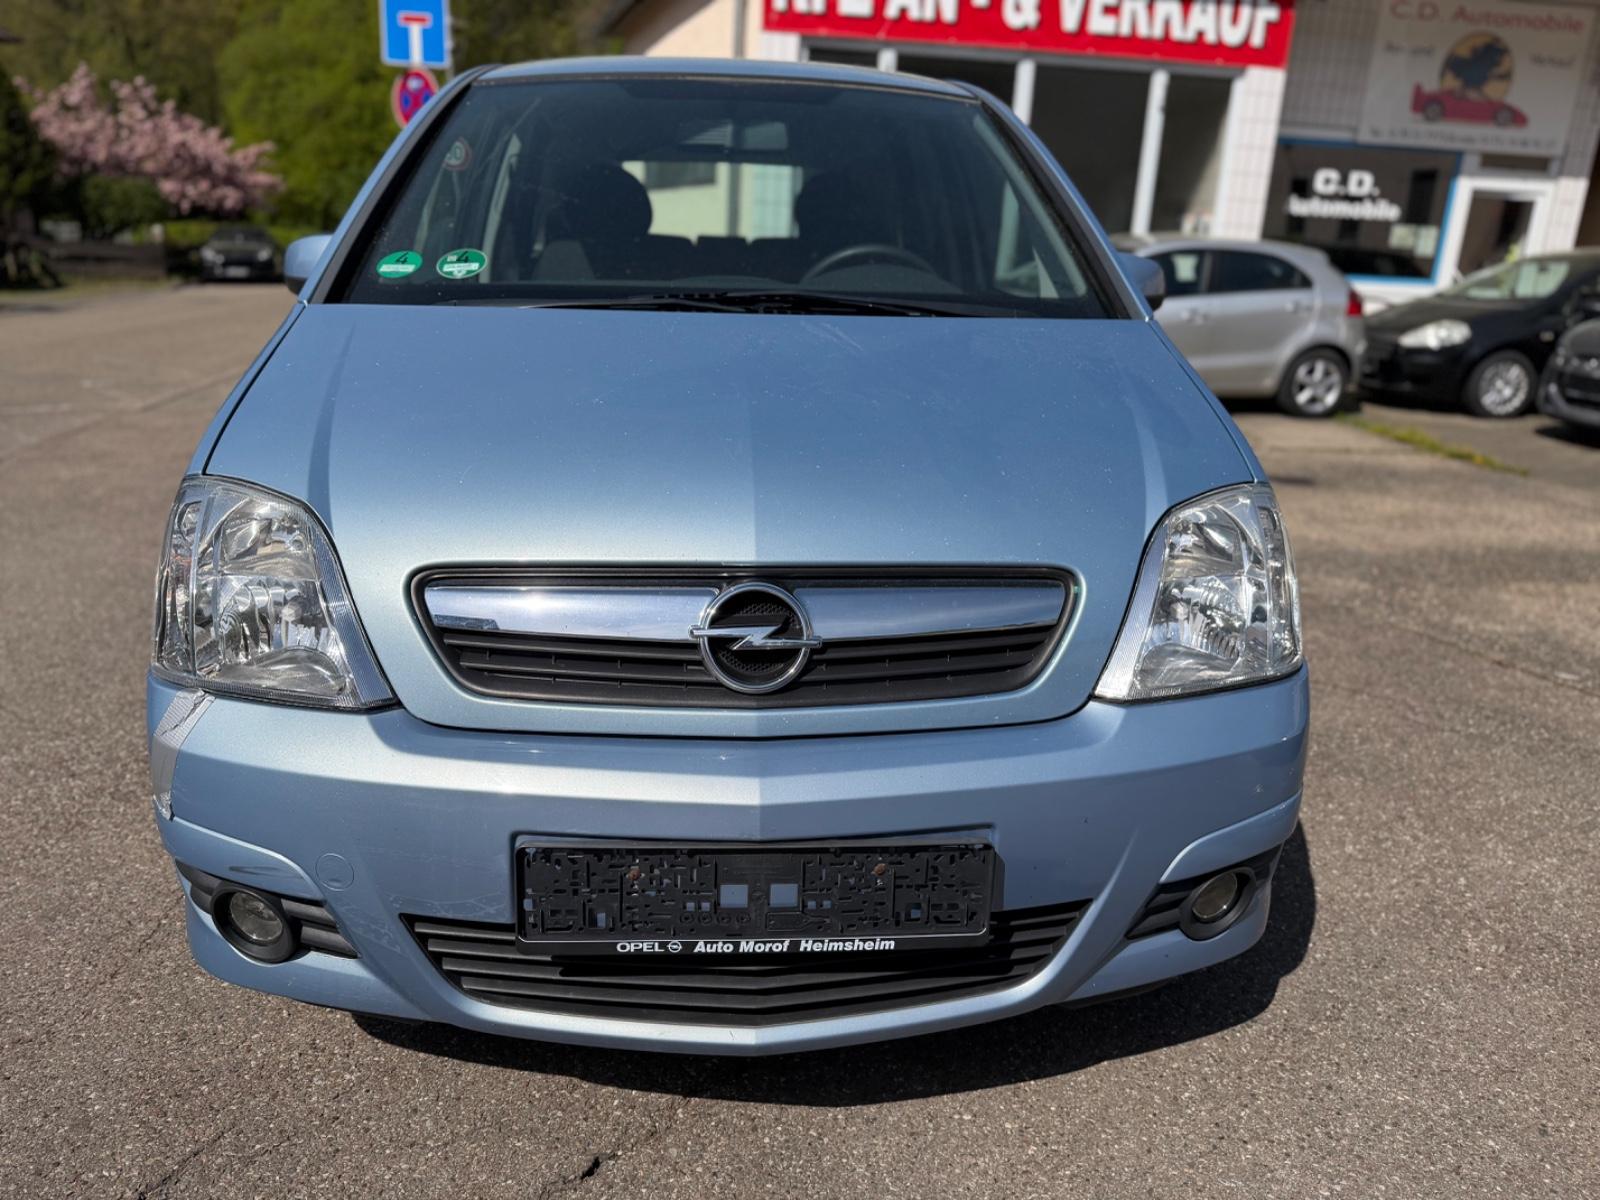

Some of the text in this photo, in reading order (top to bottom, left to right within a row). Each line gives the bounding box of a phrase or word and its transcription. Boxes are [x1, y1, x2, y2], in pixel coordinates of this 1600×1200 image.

[1059, 0, 1281, 49] VERKAUF
[1453, 5, 1585, 33] Automobile
[616, 938, 896, 953] OPEL Auto Morof Heimsheim
